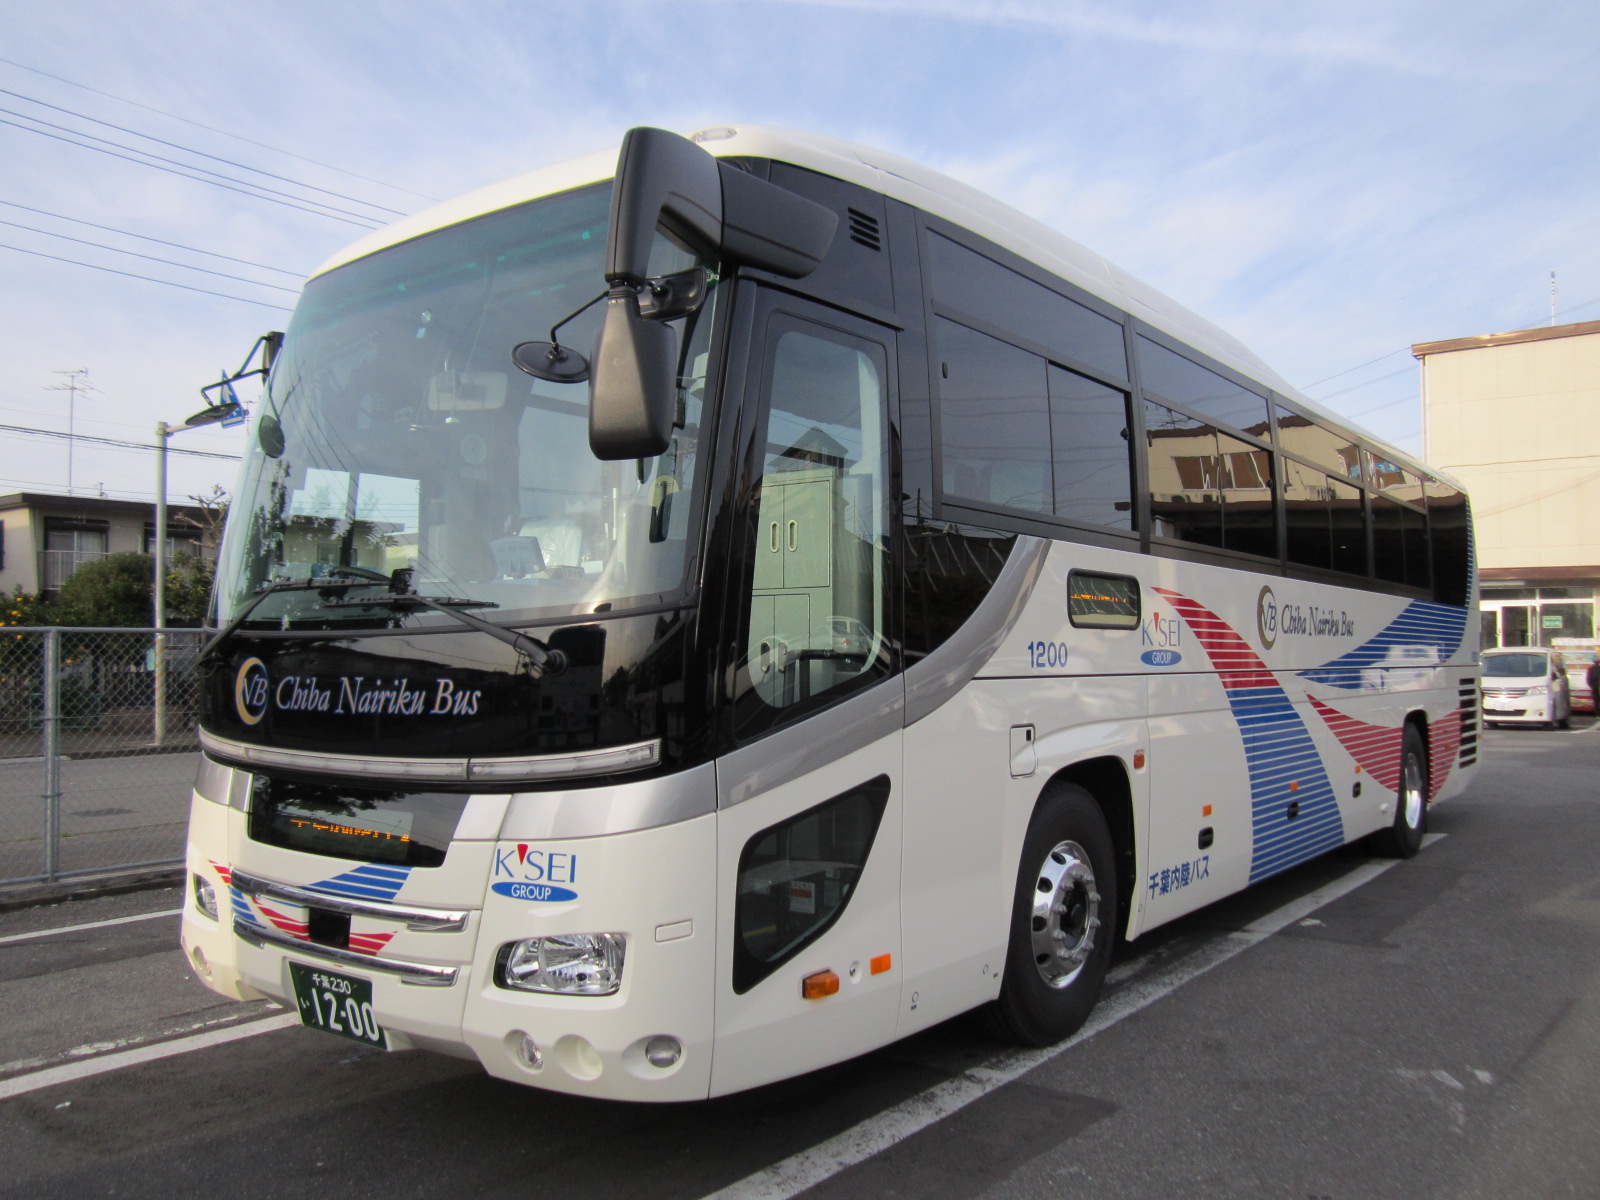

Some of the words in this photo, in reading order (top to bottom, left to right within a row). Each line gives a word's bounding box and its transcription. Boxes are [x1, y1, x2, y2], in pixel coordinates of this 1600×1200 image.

[1281, 604, 1306, 635] Chiba
[1308, 606, 1340, 637] Nairiku
[1341, 611, 1354, 637] Bus
[1028, 640, 1068, 668] 1200
[1151, 651, 1172, 664] GROUP
[275, 675, 331, 710] Chiba
[333, 676, 426, 715] Nairiku
[430, 677, 482, 715] Bus
[1149, 854, 1210, 900] 千葉内陸バス
[511, 884, 552, 901] GROUP
